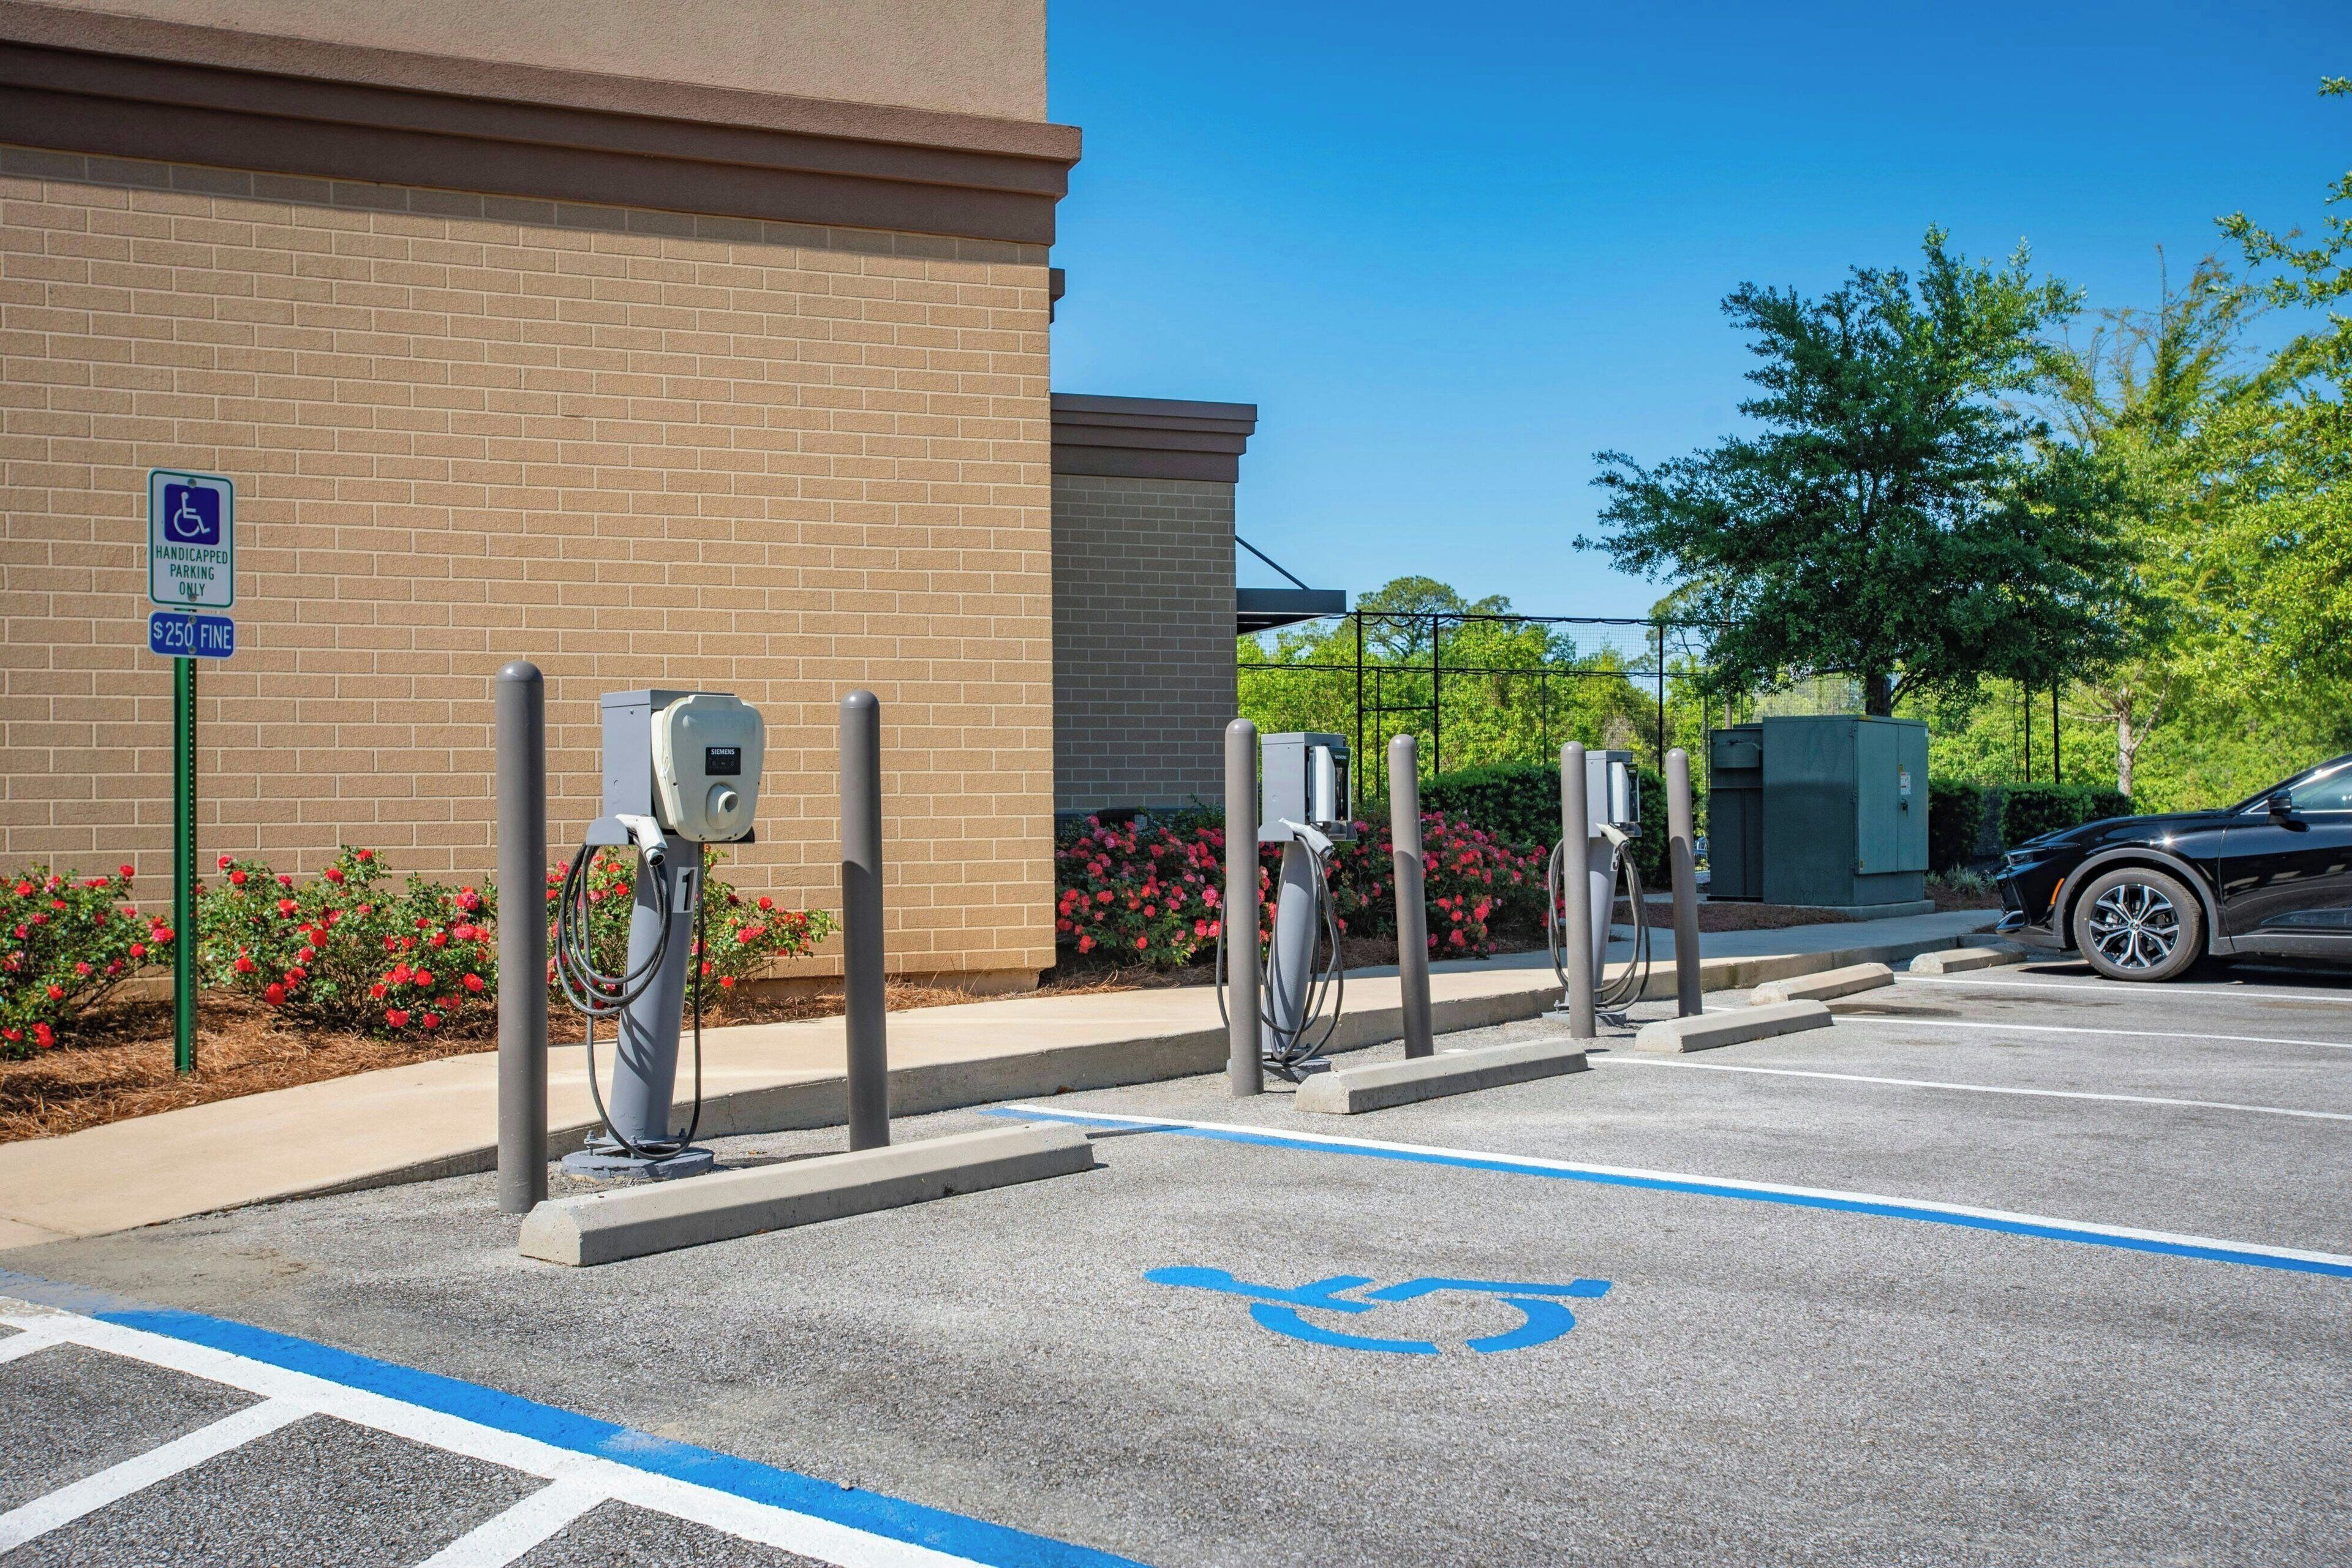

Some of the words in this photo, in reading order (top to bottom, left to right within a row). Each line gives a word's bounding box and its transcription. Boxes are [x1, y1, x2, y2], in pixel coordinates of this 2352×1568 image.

[156, 545, 228, 564] HANDICAPPED
[170, 564, 214, 580] PARKING
[179, 581, 205, 596] ONLY
[153, 620, 193, 647] $250
[201, 624, 232, 649] FINE
[682, 869, 695, 911] 1
